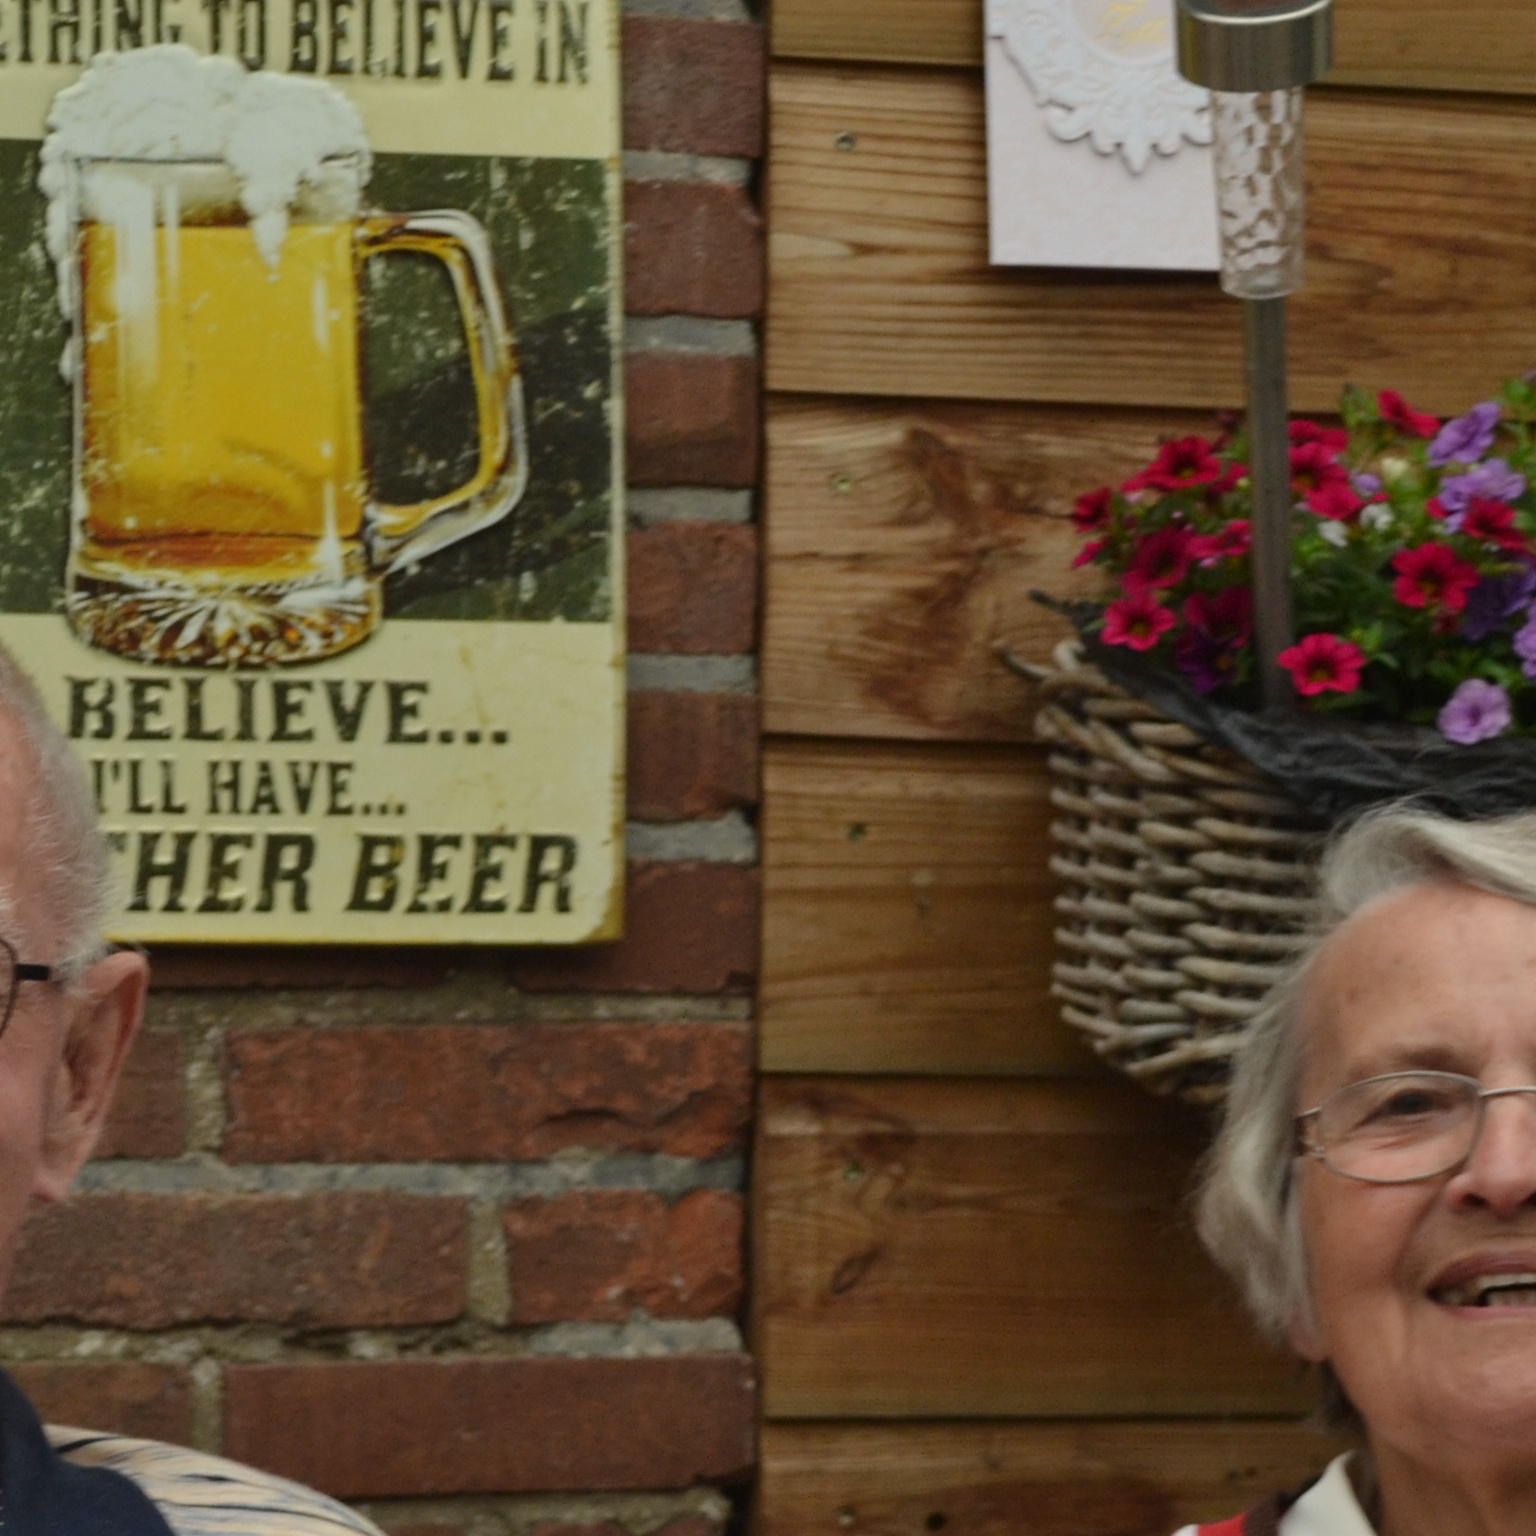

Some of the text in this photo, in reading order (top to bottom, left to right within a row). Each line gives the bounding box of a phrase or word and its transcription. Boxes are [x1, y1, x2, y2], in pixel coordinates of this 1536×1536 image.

[202, 0, 264, 70] TO
[288, 0, 513, 80] BELIEVE
[534, 0, 588, 83] IN
[66, 676, 508, 743] BELIEVE...
[205, 760, 406, 815] HAVE...
[106, 832, 577, 913] HER BEER
